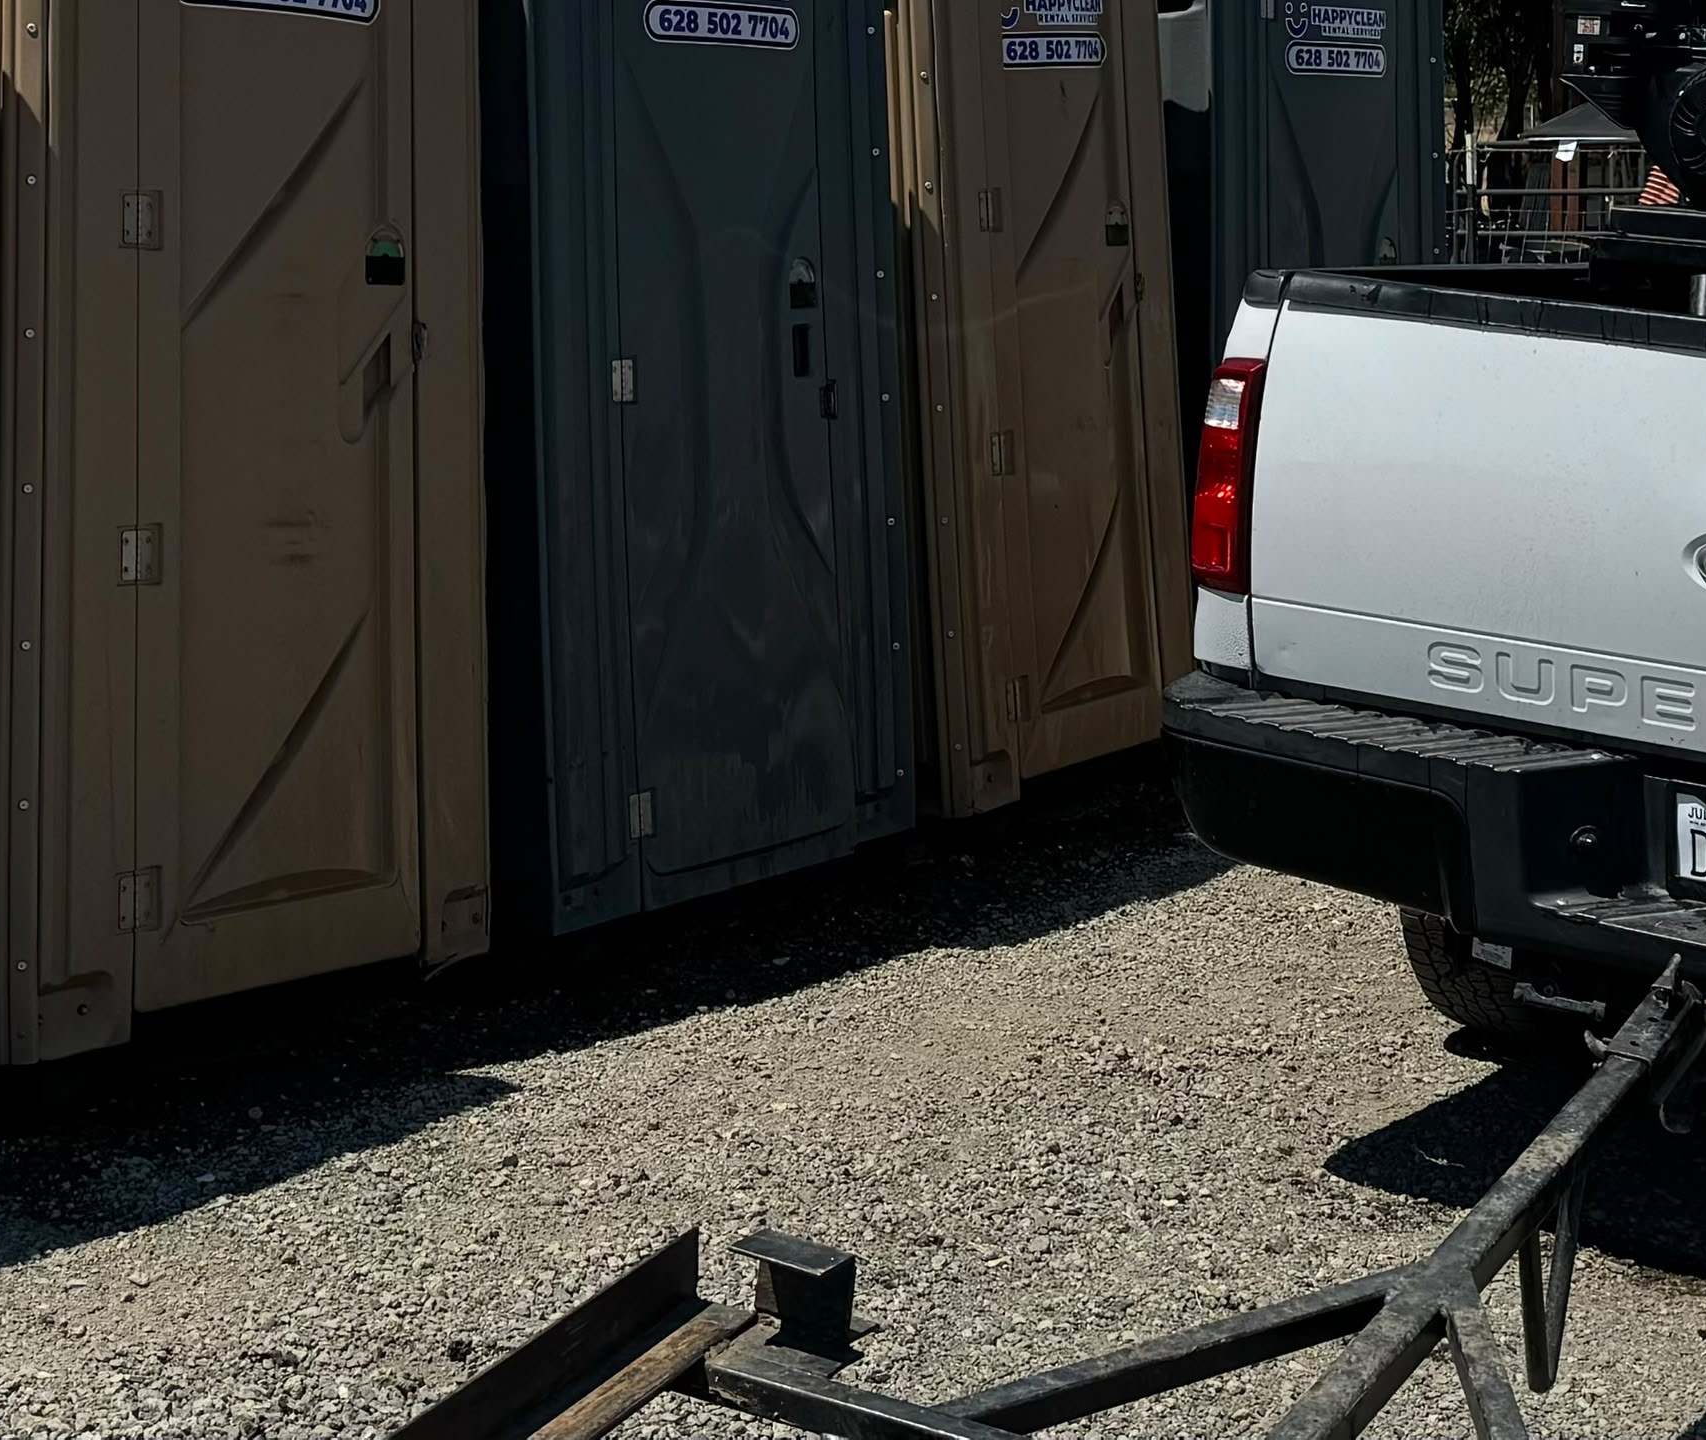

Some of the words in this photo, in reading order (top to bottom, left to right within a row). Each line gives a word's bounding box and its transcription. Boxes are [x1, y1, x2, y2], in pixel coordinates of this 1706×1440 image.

[659, 8, 699, 33] 628
[707, 12, 742, 35] 502
[748, 15, 790, 40] 7704
[1312, 7, 1386, 28] HAPPYCLEAN
[1006, 40, 1040, 61] 628
[1045, 40, 1072, 60] 502
[1075, 40, 1100, 60] 7704
[1295, 48, 1322, 67] 628
[1327, 49, 1350, 69] 502
[1354, 51, 1381, 70] 7704
